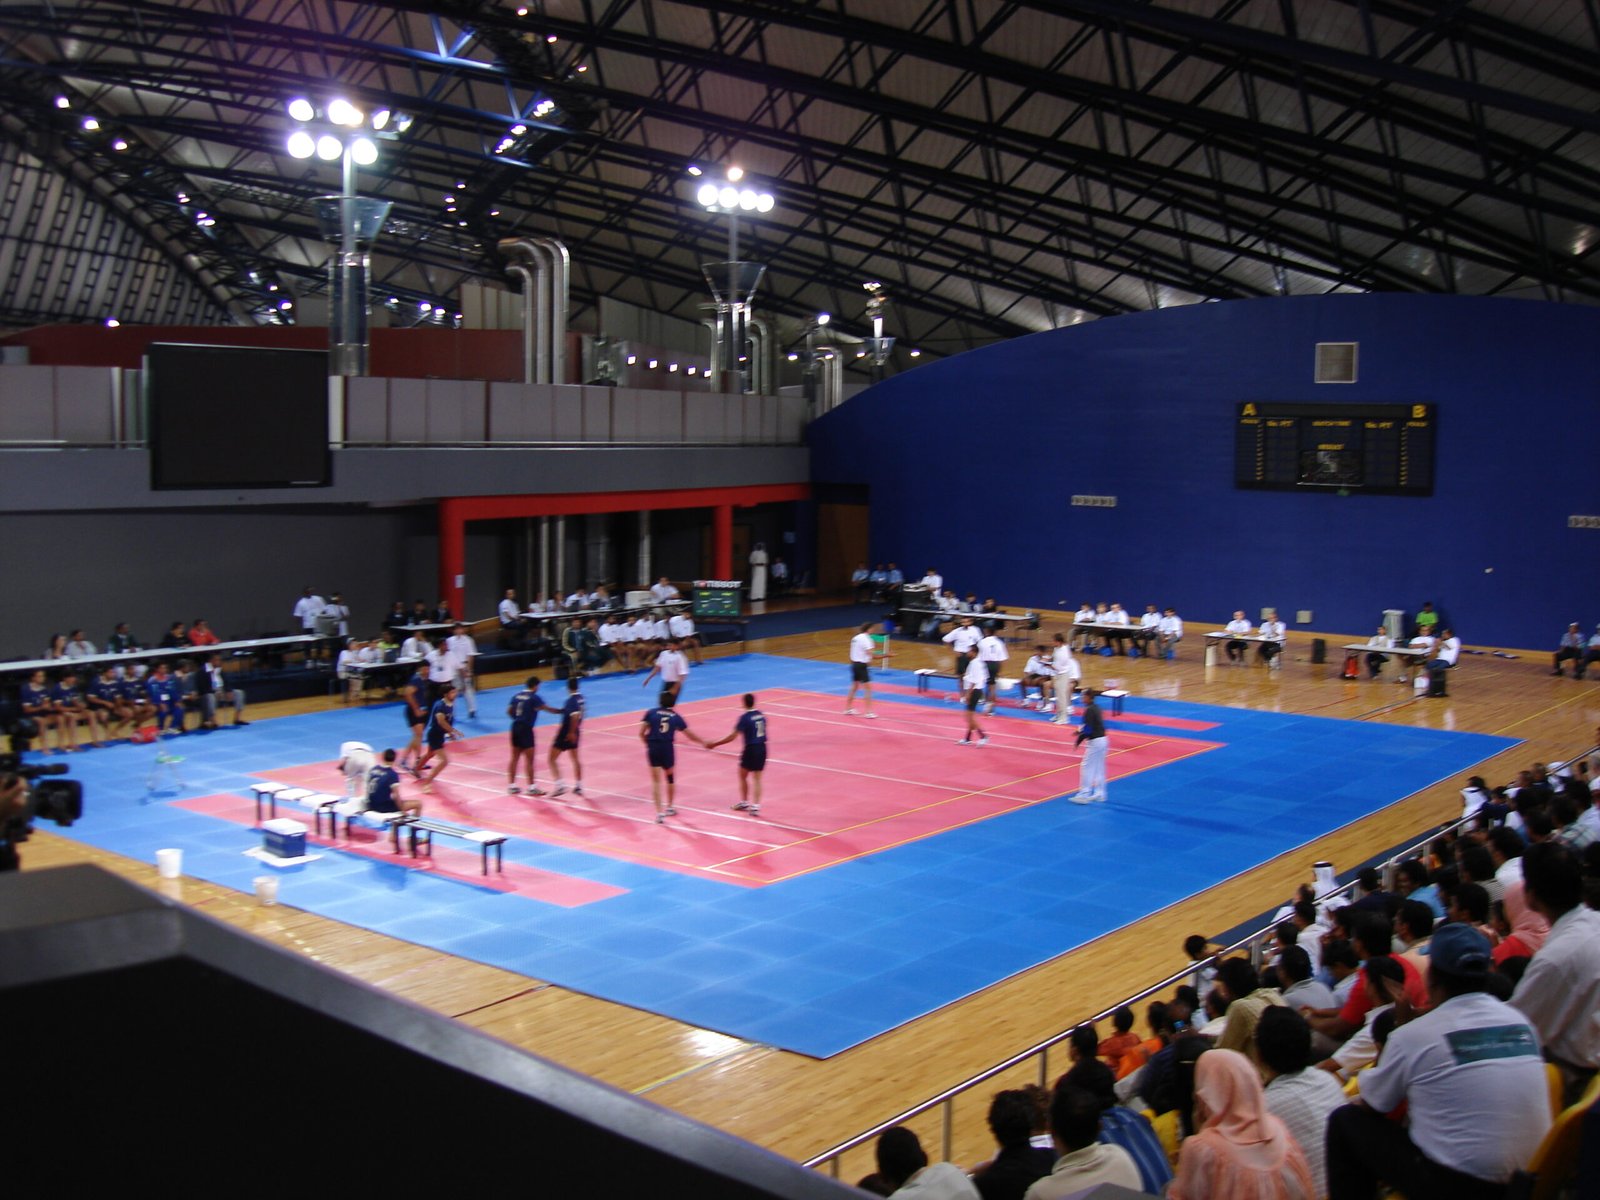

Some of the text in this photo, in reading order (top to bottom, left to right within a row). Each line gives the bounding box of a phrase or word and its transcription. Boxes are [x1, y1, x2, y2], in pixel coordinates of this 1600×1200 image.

[1242, 403, 1257, 416] A
[1412, 405, 1426, 418] B
[706, 580, 742, 589] TISSOT
[659, 717, 670, 733] 5
